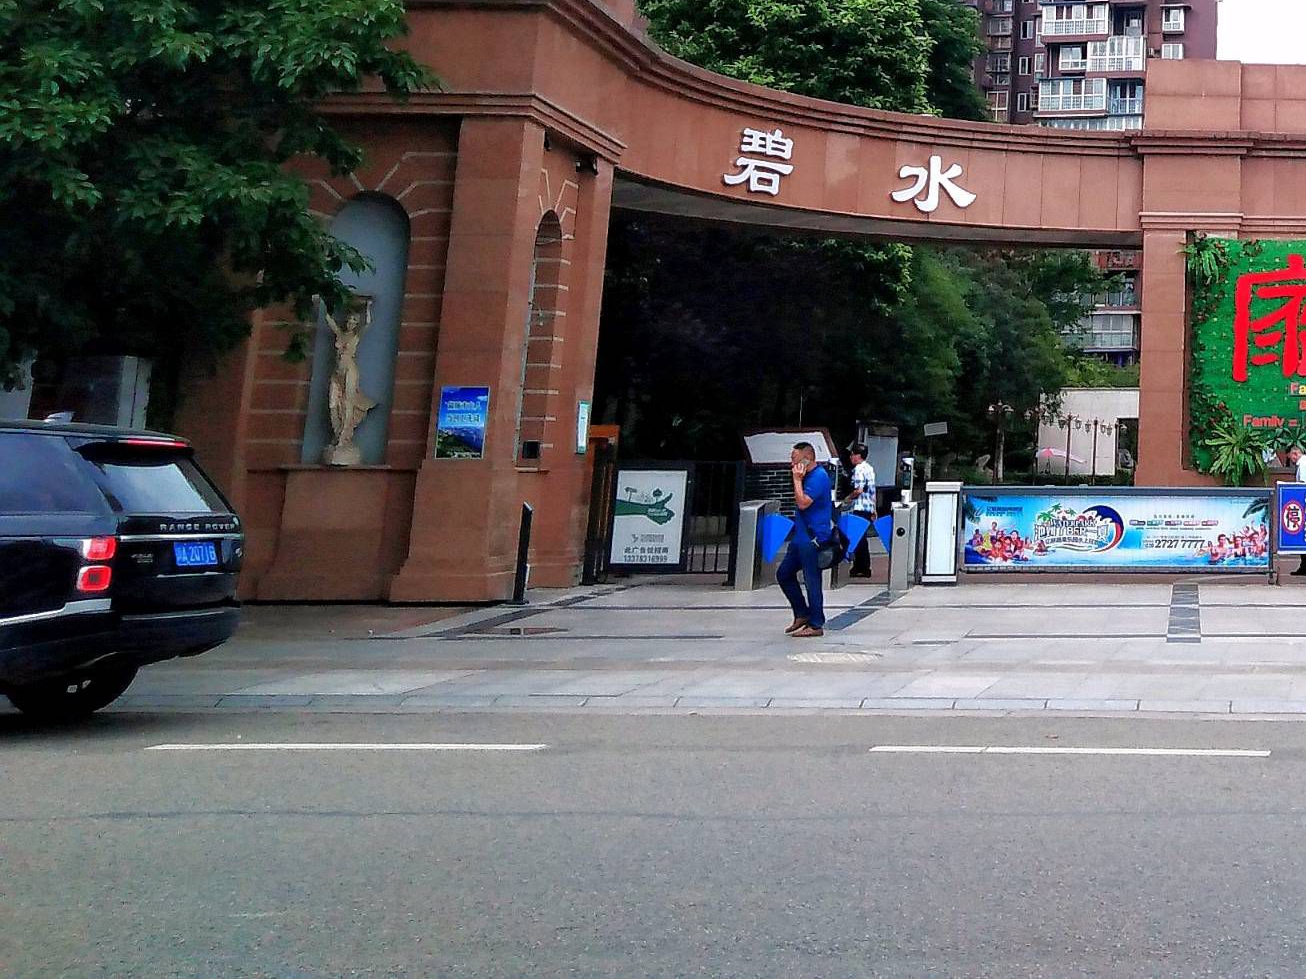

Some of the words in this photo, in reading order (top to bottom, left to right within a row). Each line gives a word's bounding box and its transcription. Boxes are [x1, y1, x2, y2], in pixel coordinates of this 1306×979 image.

[1243, 414, 1285, 428] Family
[160, 523, 200, 531] RANGE
[205, 523, 235, 531] ROVER
[1154, 539, 1178, 549] 2727
